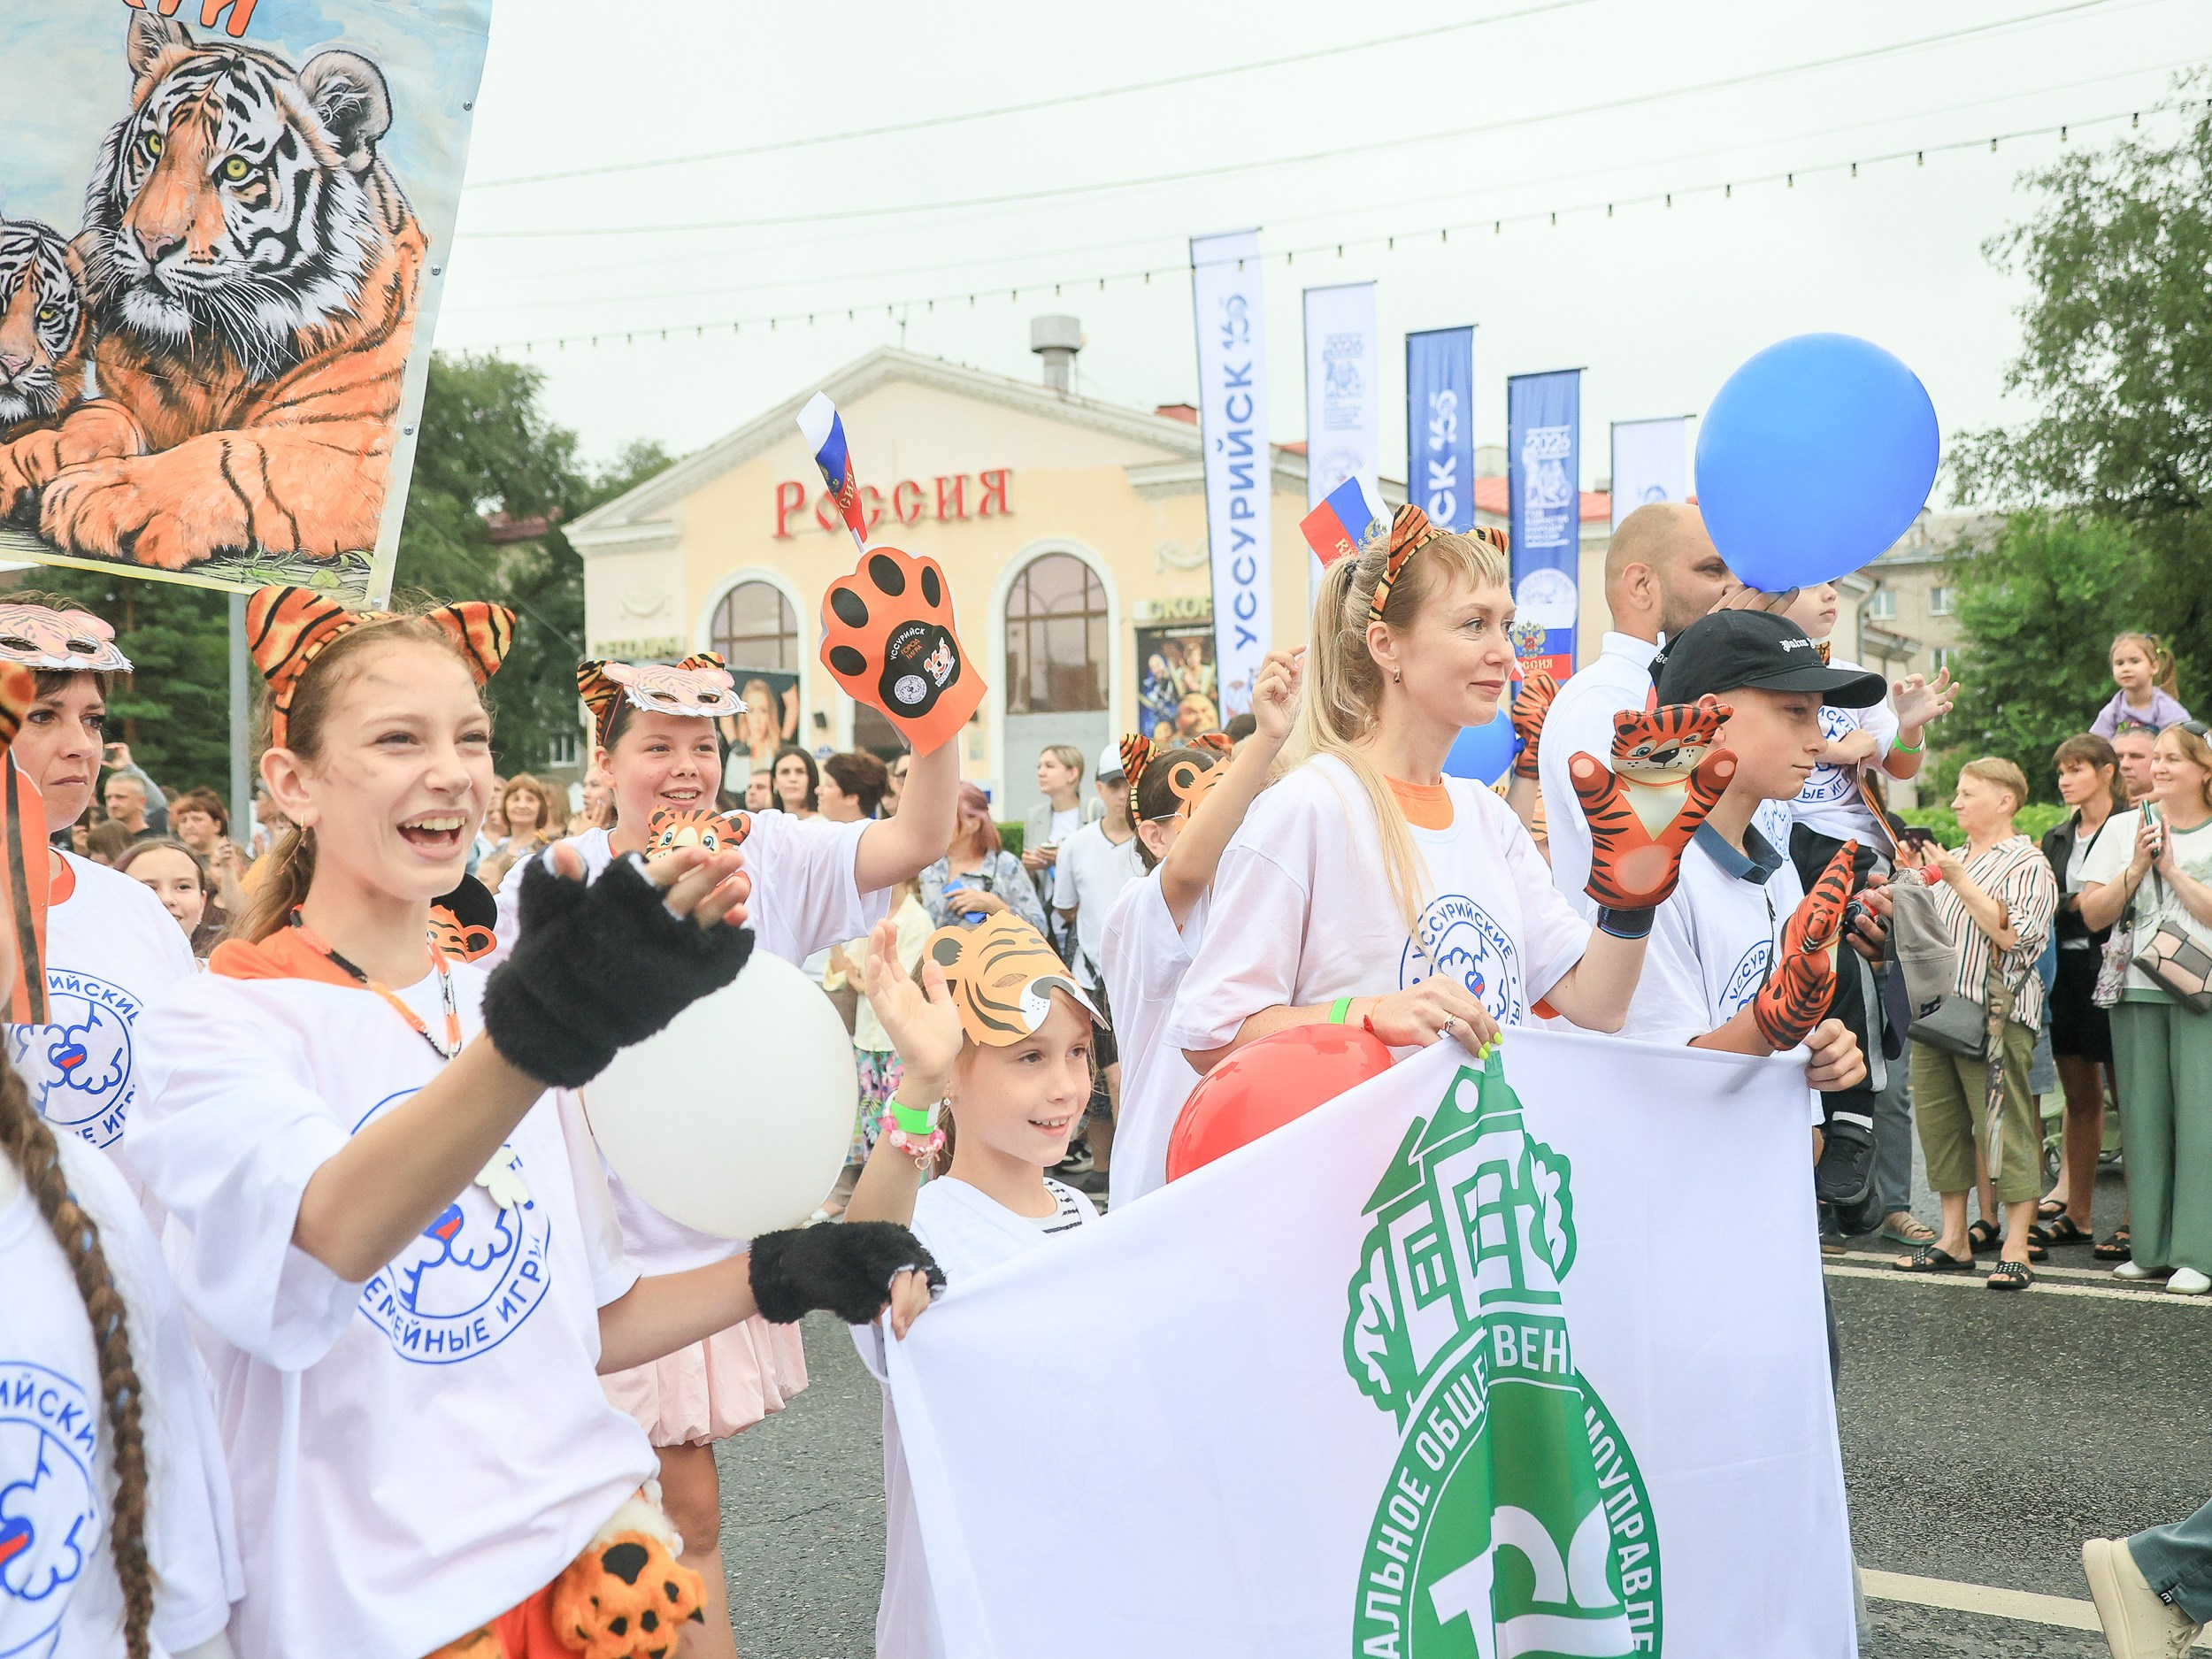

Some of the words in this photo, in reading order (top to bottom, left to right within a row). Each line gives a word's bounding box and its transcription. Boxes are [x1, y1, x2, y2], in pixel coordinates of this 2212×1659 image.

[774, 468, 1014, 539] РОССИЯ
[839, 471, 854, 515] СИЯ
[1217, 361, 1256, 651] УССУРИЙСК
[1428, 455, 1457, 533] СК
[890, 627, 926, 661] УССУРИЙСК
[901, 638, 921, 656] ГОРОД
[906, 645, 924, 660] ТИГРА
[1412, 902, 1513, 960] УССУРИЙСКИЕ
[1730, 949, 1769, 999] УССУР
[1416, 1354, 1491, 1471] ОБЩЕ
